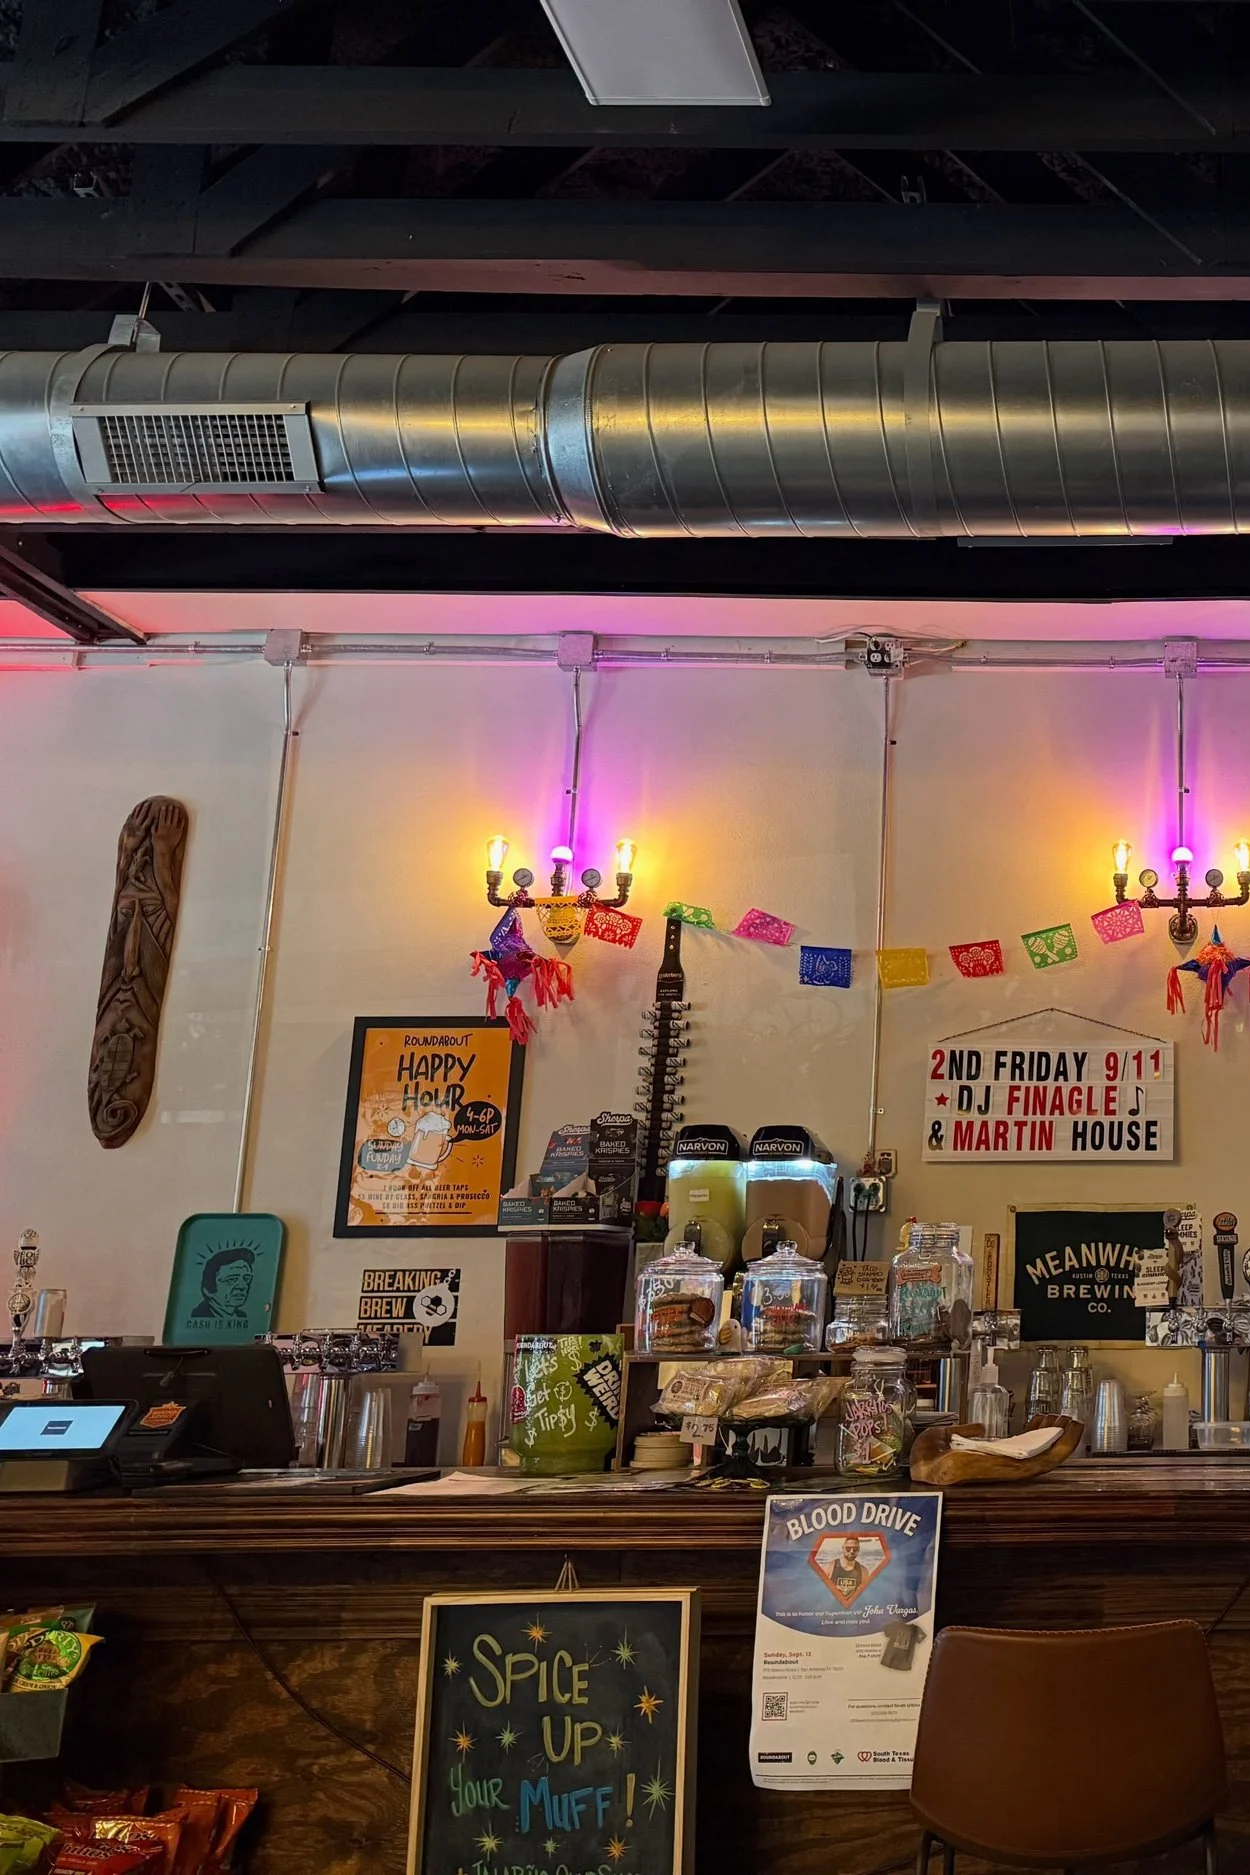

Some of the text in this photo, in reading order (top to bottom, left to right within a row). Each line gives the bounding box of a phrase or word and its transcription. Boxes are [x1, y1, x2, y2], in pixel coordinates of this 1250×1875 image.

[404, 1033, 473, 1048] ROUNDABOUT
[397, 1051, 476, 1083] HAPPY
[930, 1049, 1161, 1082] 2ND FRIDAY 9/11
[957, 1085, 1117, 1116] DJ FINAGLE
[466, 1107, 495, 1122] 4-6P
[597, 1113, 633, 1126] Sherpa
[456, 1123, 498, 1135] MON-SAT
[927, 1120, 1158, 1151] & MARTIN HOUSE
[679, 1142, 726, 1152] NARVON
[754, 1142, 801, 1153] NARVON
[366, 1151, 402, 1165] FUNDAY
[407, 1184, 469, 1192] OFF ALL BEER TAPS
[1025, 1242, 1138, 1285] MEANWH
[363, 1270, 441, 1291] BREAKING
[1047, 1284, 1136, 1299] BREWIN
[360, 1297, 407, 1318] BREW
[1087, 1302, 1111, 1313] CO.
[186, 1318, 249, 1330] CASH IS KING
[786, 1502, 922, 1541] BLOOD DRIVE
[862, 1605, 884, 1618] John
[764, 1651, 804, 1659] Sunday, Sept.
[469, 1633, 589, 1708] SPICE
[542, 1715, 602, 1767] UP
[451, 1763, 510, 1817] YOUR
